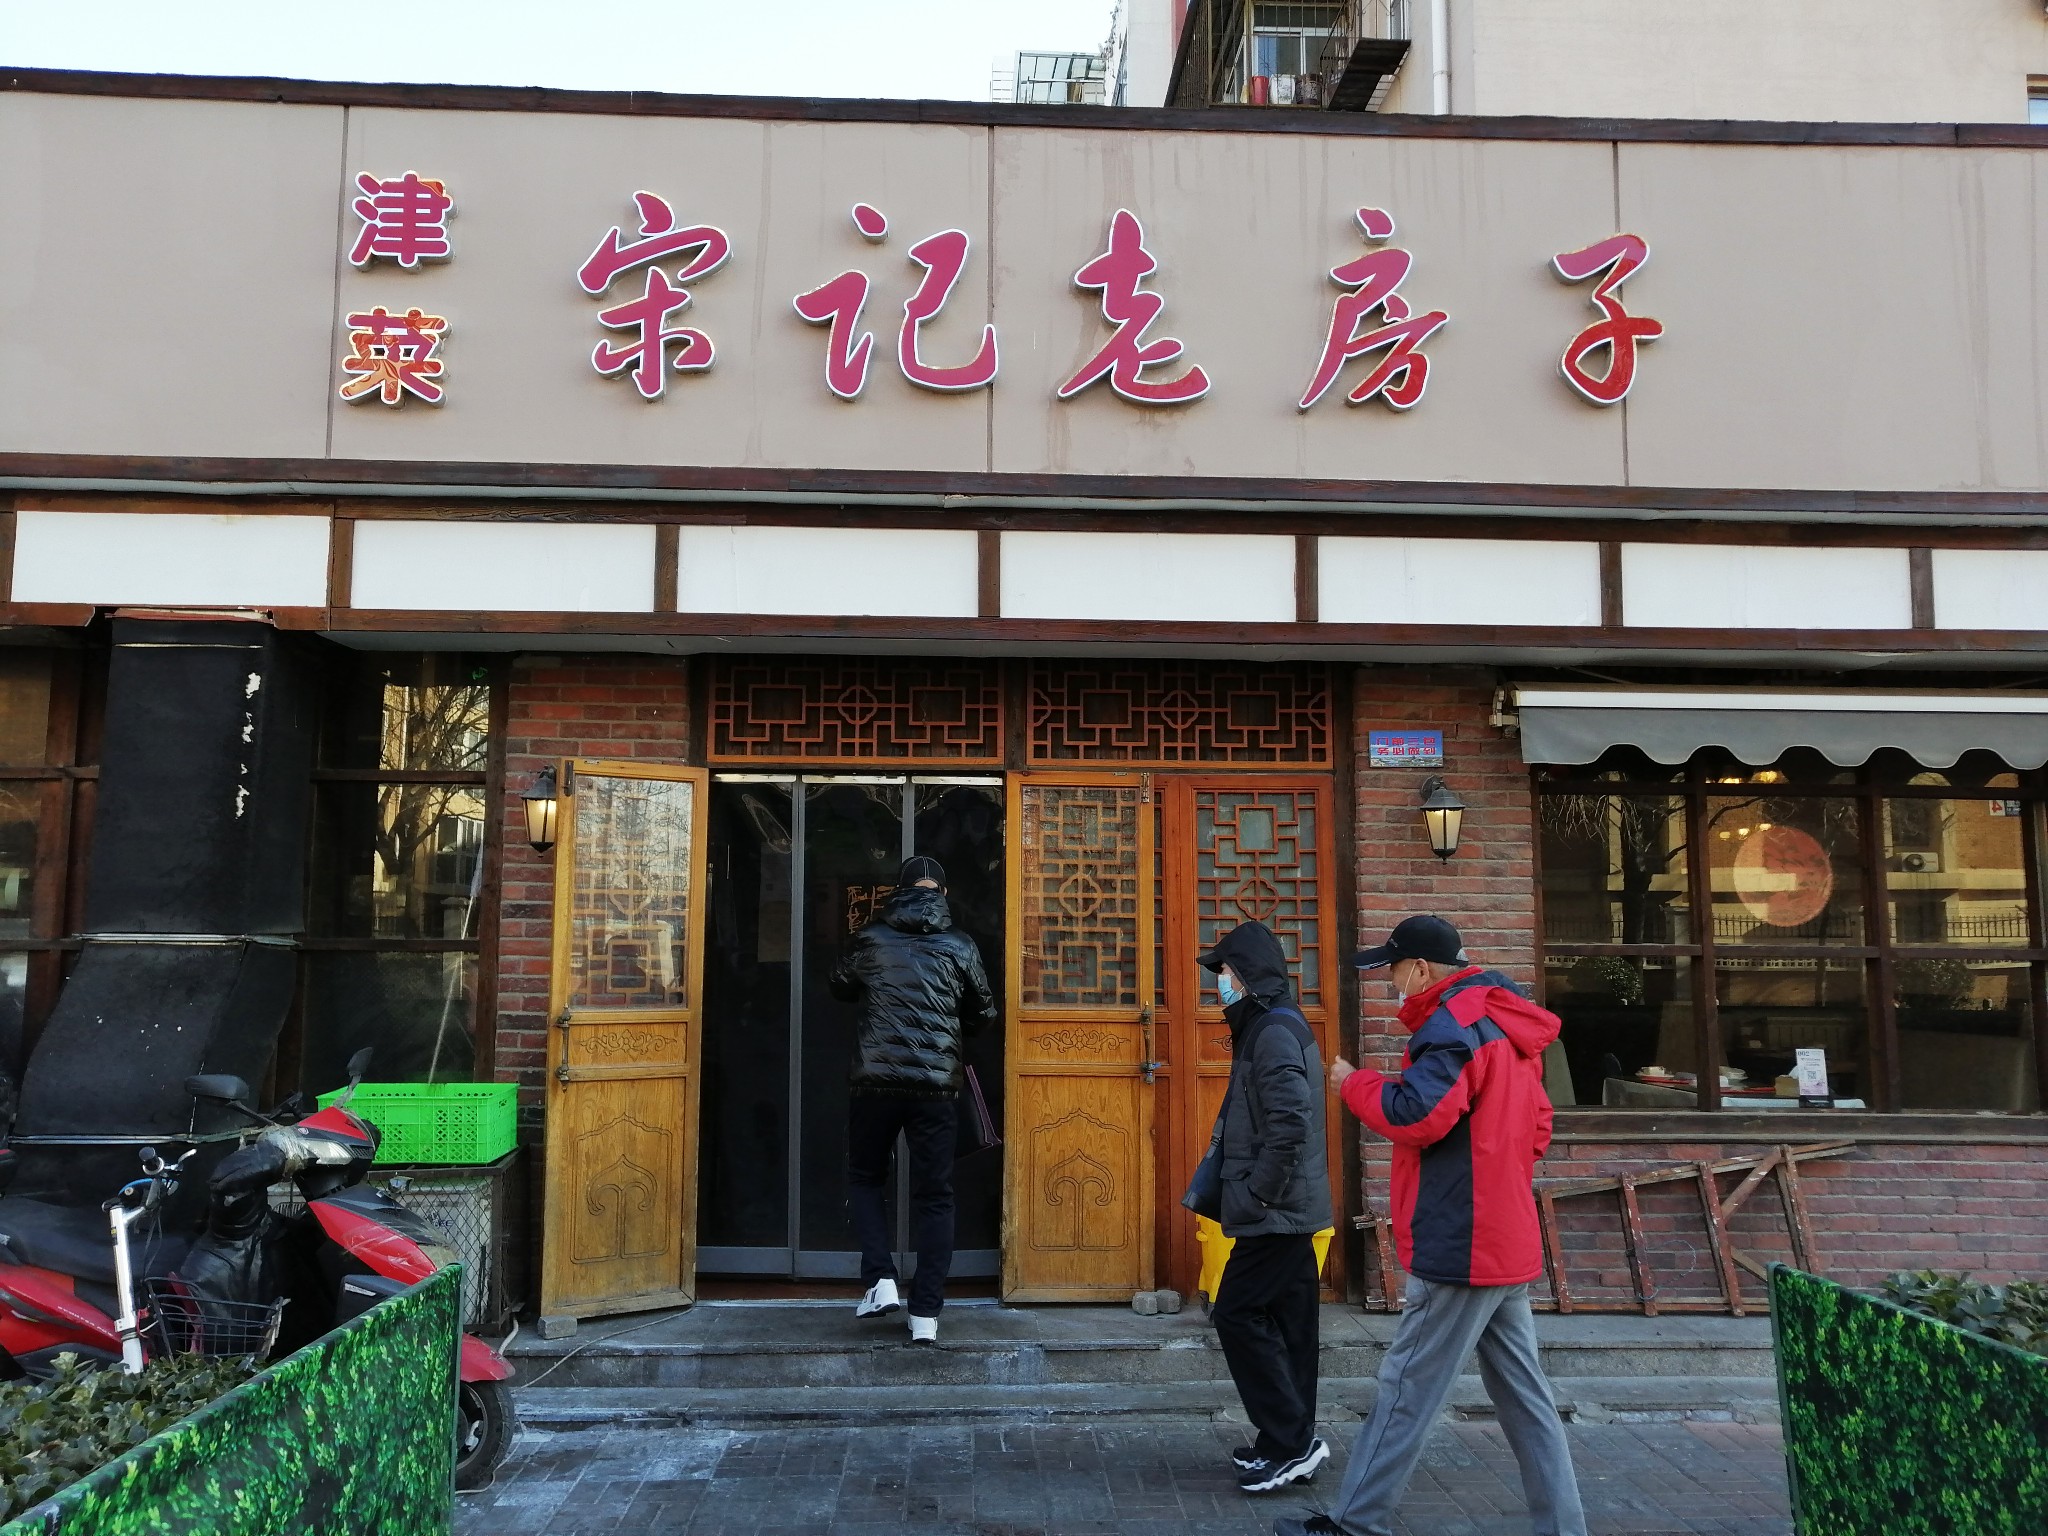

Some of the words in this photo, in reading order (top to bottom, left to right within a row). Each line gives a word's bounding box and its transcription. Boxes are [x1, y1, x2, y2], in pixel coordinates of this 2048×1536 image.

[339, 170, 453, 404] 津菜
[577, 189, 1664, 411] 宋记老房子
